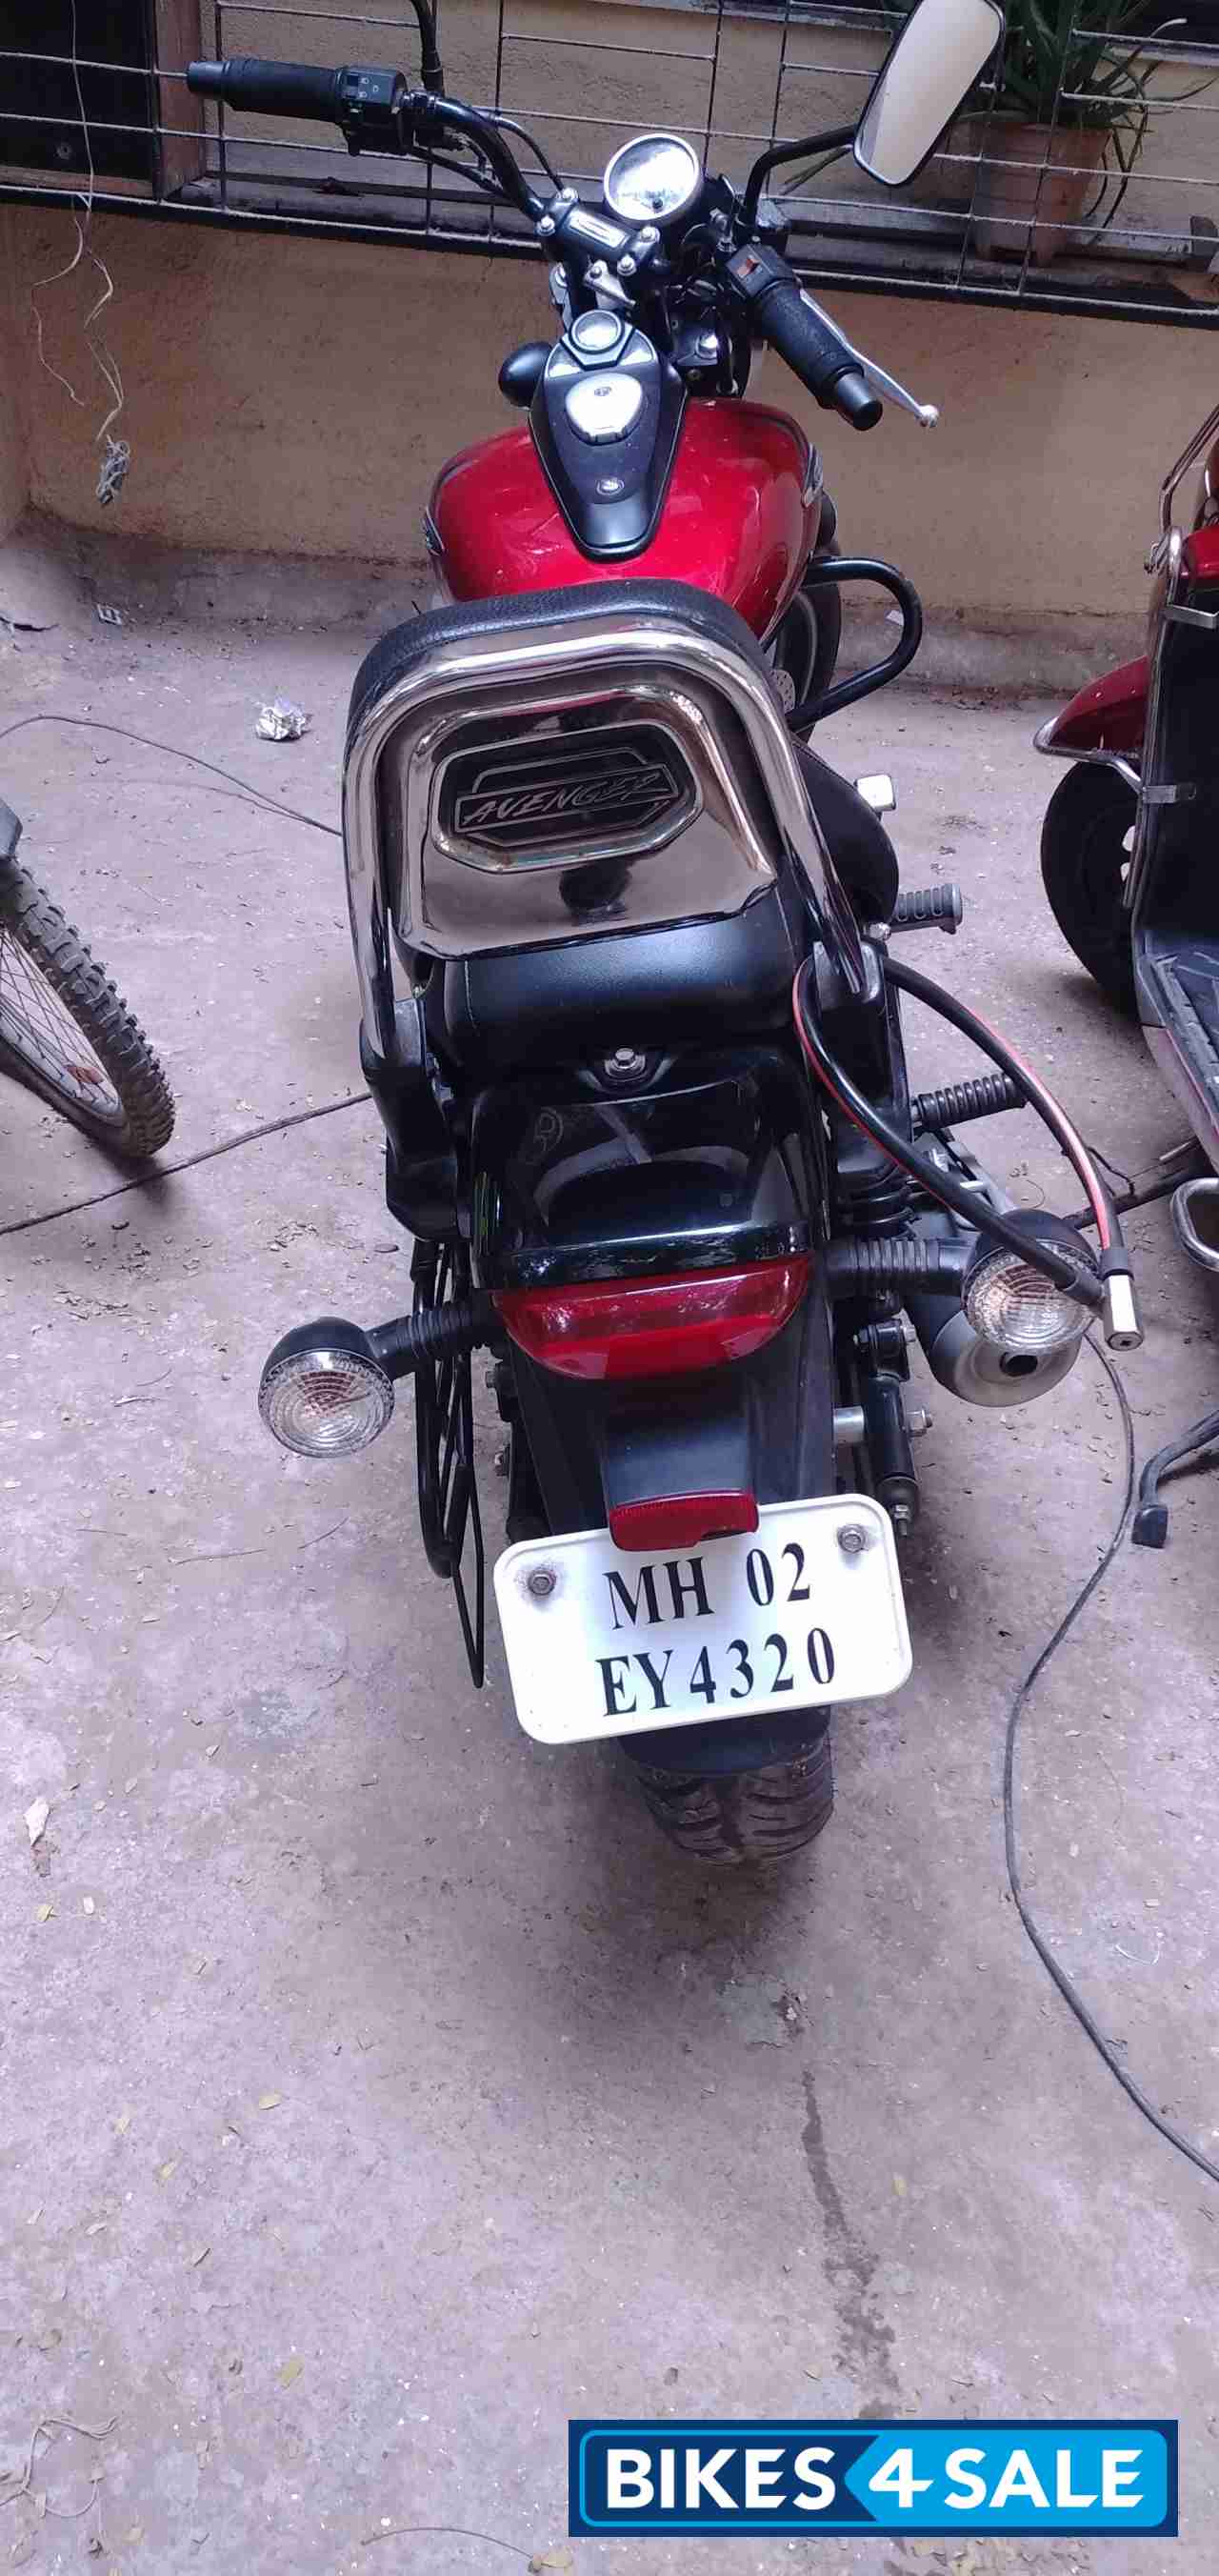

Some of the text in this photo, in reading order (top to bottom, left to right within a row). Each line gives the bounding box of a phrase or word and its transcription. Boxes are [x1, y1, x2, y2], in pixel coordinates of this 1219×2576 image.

[463, 771, 669, 826] AVENGER
[603, 1542, 811, 1630] MH 02
[594, 1627, 835, 1717] EY4320
